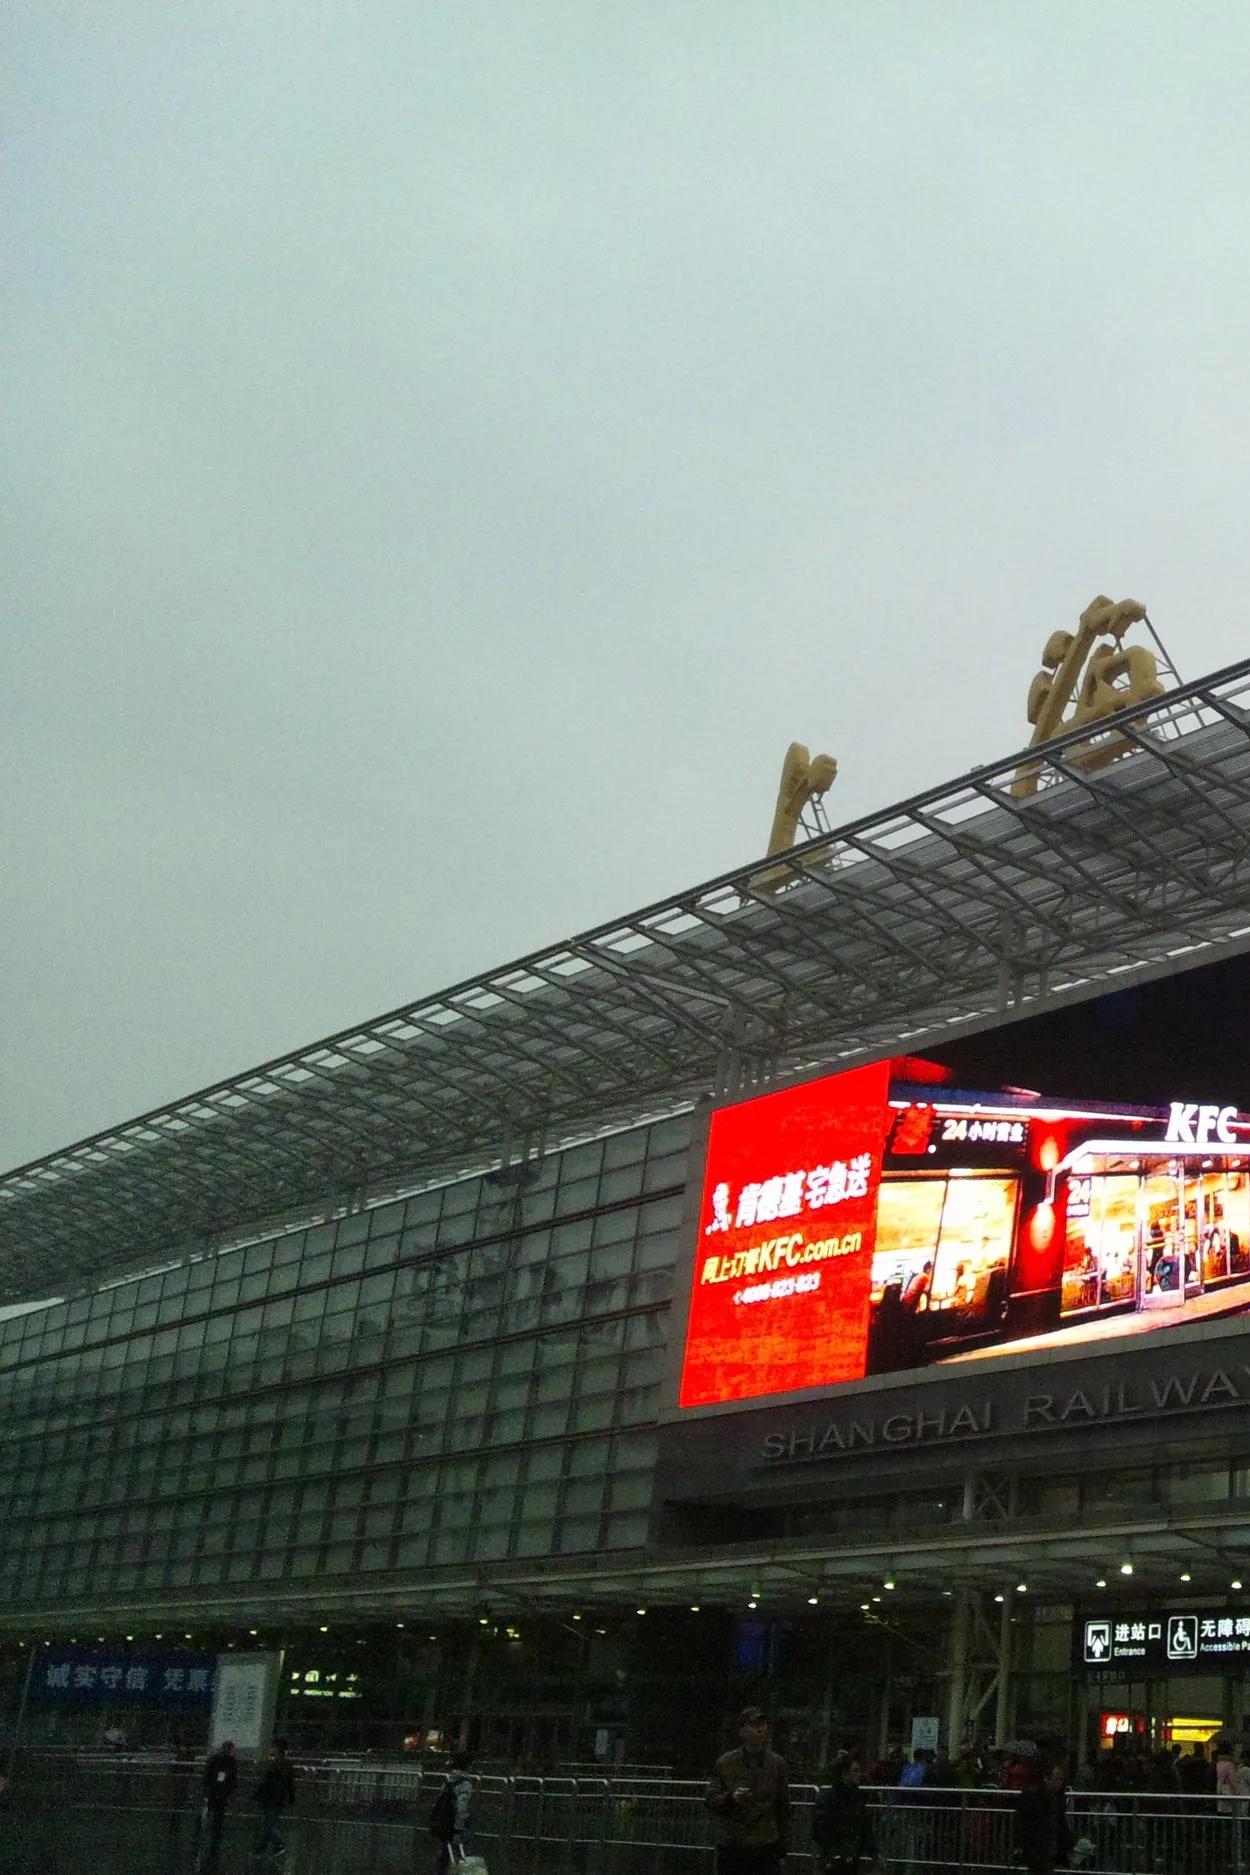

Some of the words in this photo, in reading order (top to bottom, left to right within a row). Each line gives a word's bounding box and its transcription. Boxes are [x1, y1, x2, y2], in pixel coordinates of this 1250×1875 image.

[1164, 1101, 1239, 1144] KFC
[762, 1401, 990, 1459] SHANGHAI
[1115, 1622, 1162, 1643] 进站口
[1114, 1646, 1146, 1657] Entrance
[1200, 1641, 1240, 1653] Accessible
